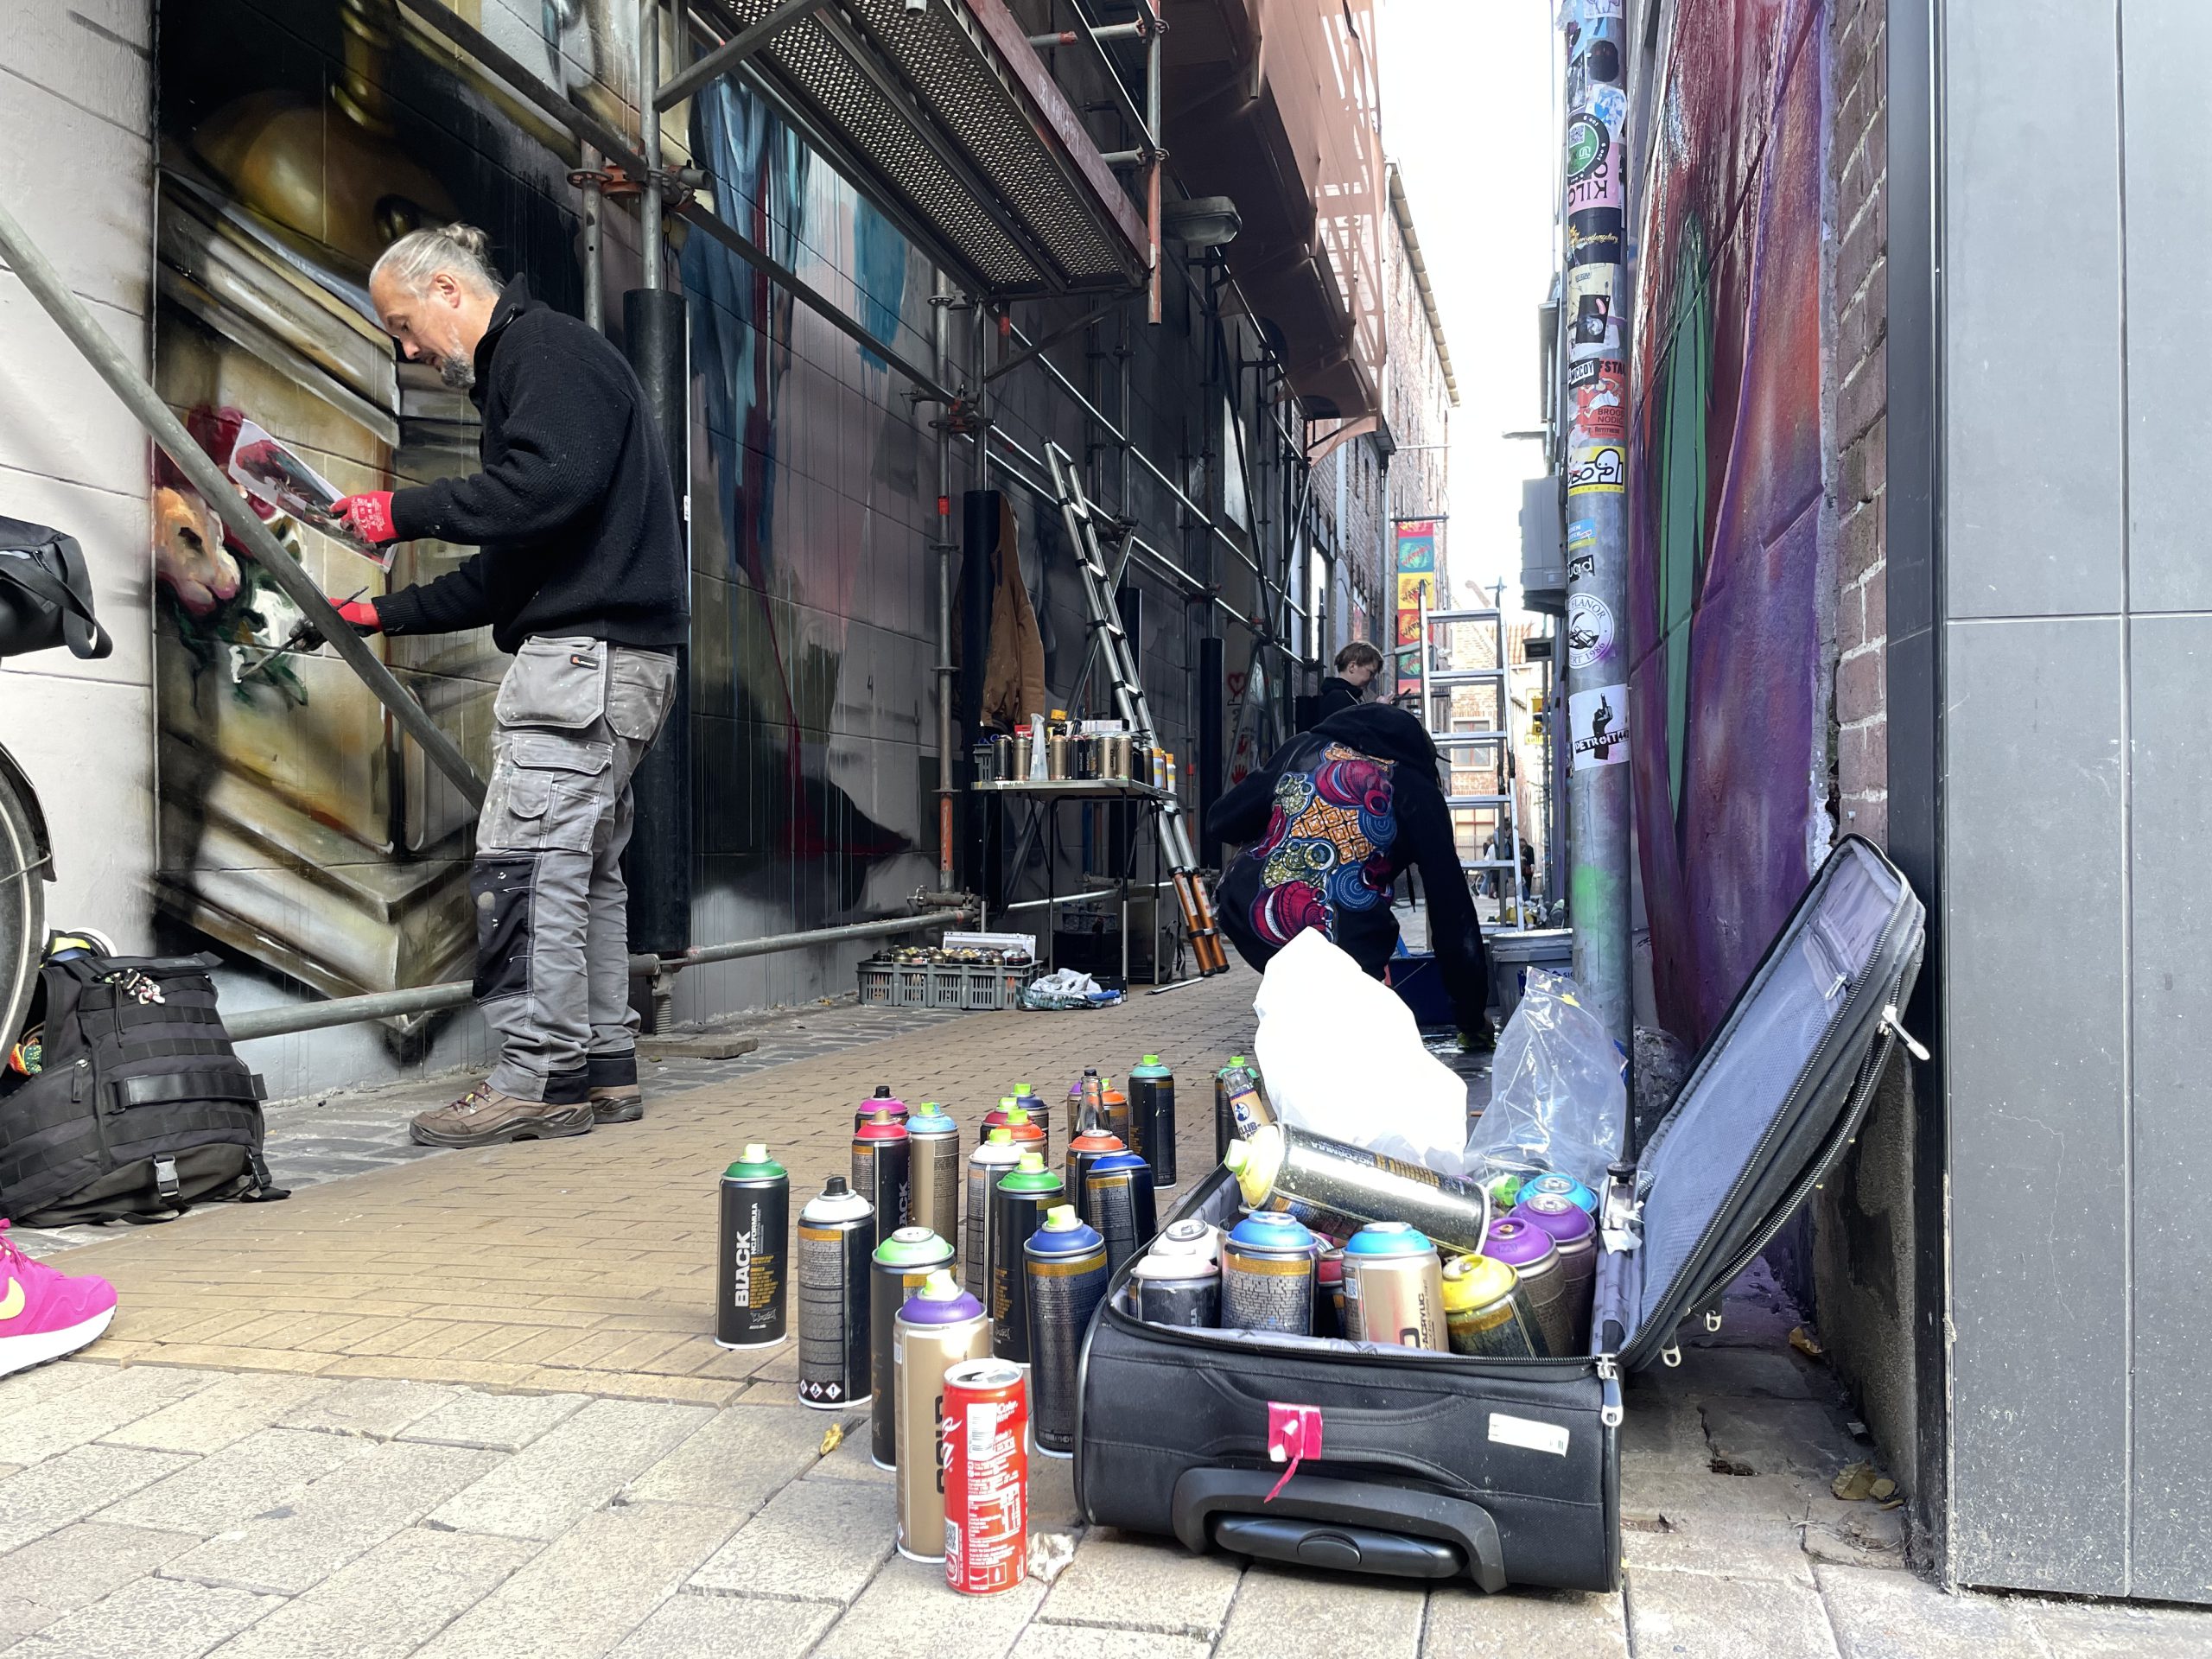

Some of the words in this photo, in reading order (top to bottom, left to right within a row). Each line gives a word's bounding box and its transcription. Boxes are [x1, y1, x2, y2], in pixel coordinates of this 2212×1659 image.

[1586, 641, 1605, 660] 1986
[1575, 732, 1617, 750] DETROIT
[899, 1181, 908, 1227] ACK
[734, 1230, 751, 1307] BLACK
